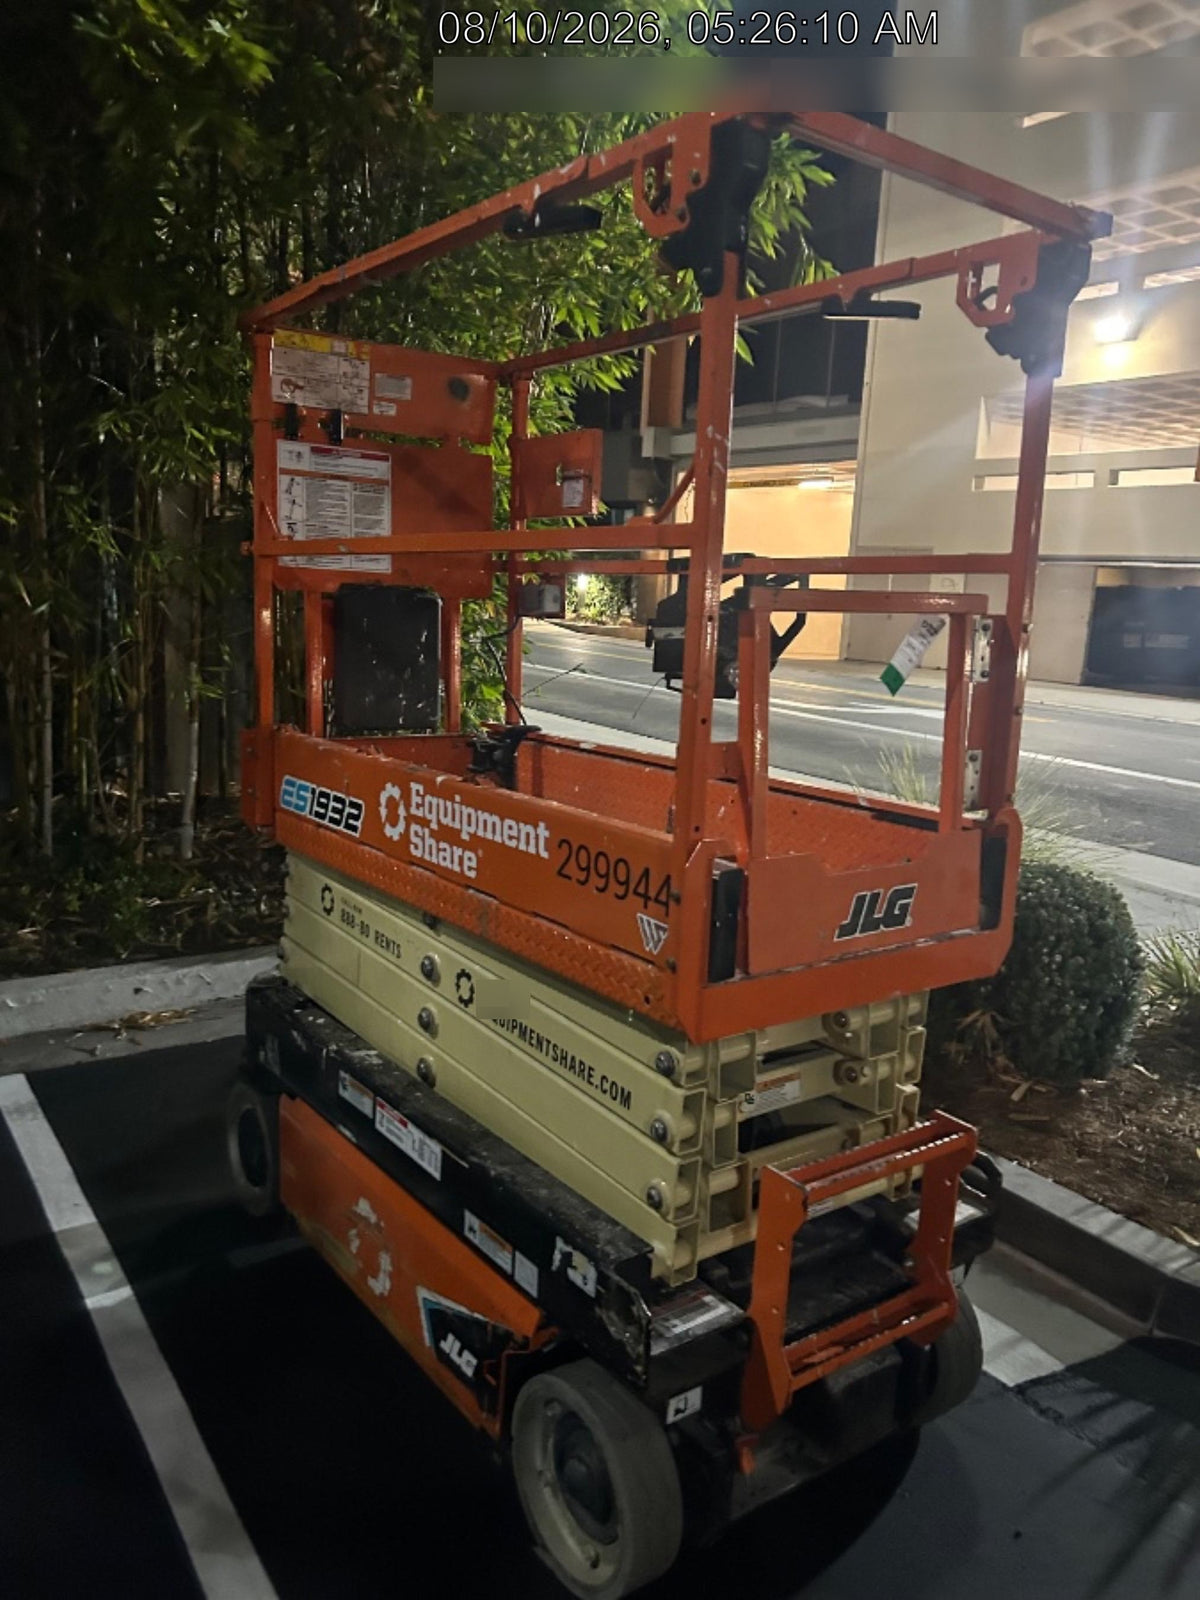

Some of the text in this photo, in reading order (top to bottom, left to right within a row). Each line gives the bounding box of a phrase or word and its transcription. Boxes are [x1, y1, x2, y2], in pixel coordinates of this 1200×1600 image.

[280, 775, 365, 837] ES1932
[410, 781, 549, 859] Equipment
[410, 823, 477, 879] Share
[557, 838, 671, 917] 299944
[834, 883, 918, 942] JLG
[374, 929, 401, 959] RENTS
